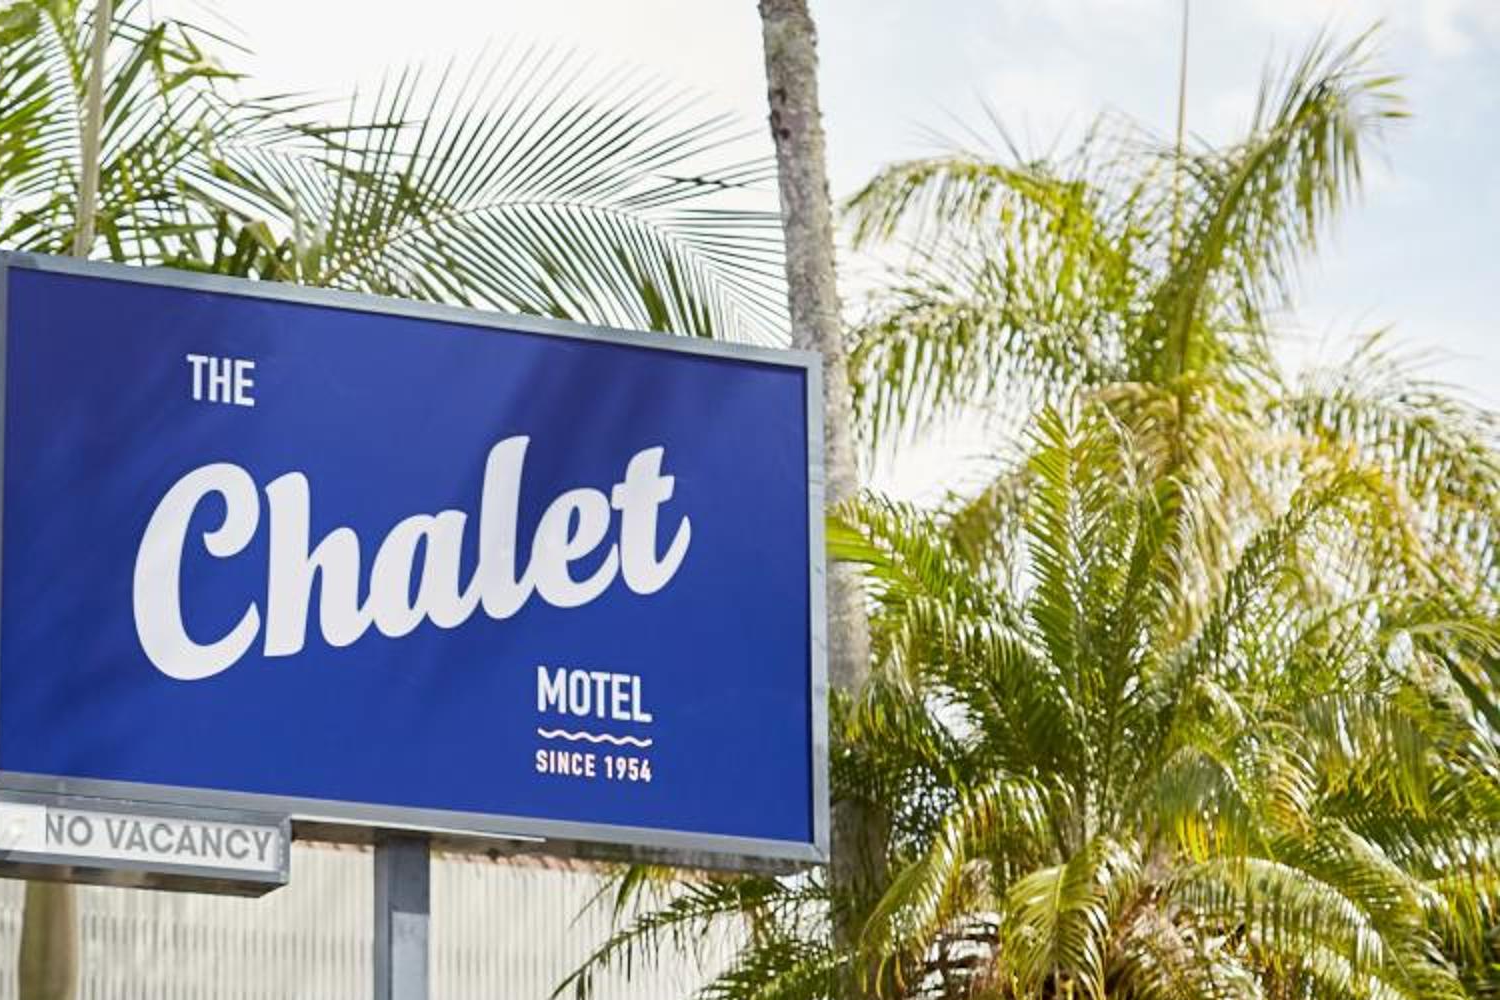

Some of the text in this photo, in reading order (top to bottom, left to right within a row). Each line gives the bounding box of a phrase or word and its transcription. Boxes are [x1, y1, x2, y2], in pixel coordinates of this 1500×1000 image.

[186, 353, 256, 408] THE
[132, 434, 692, 681] Chalet
[537, 665, 653, 723] MOTEL
[535, 748, 653, 783] SINCE 1954
[46, 814, 273, 862] NO VACANCY
